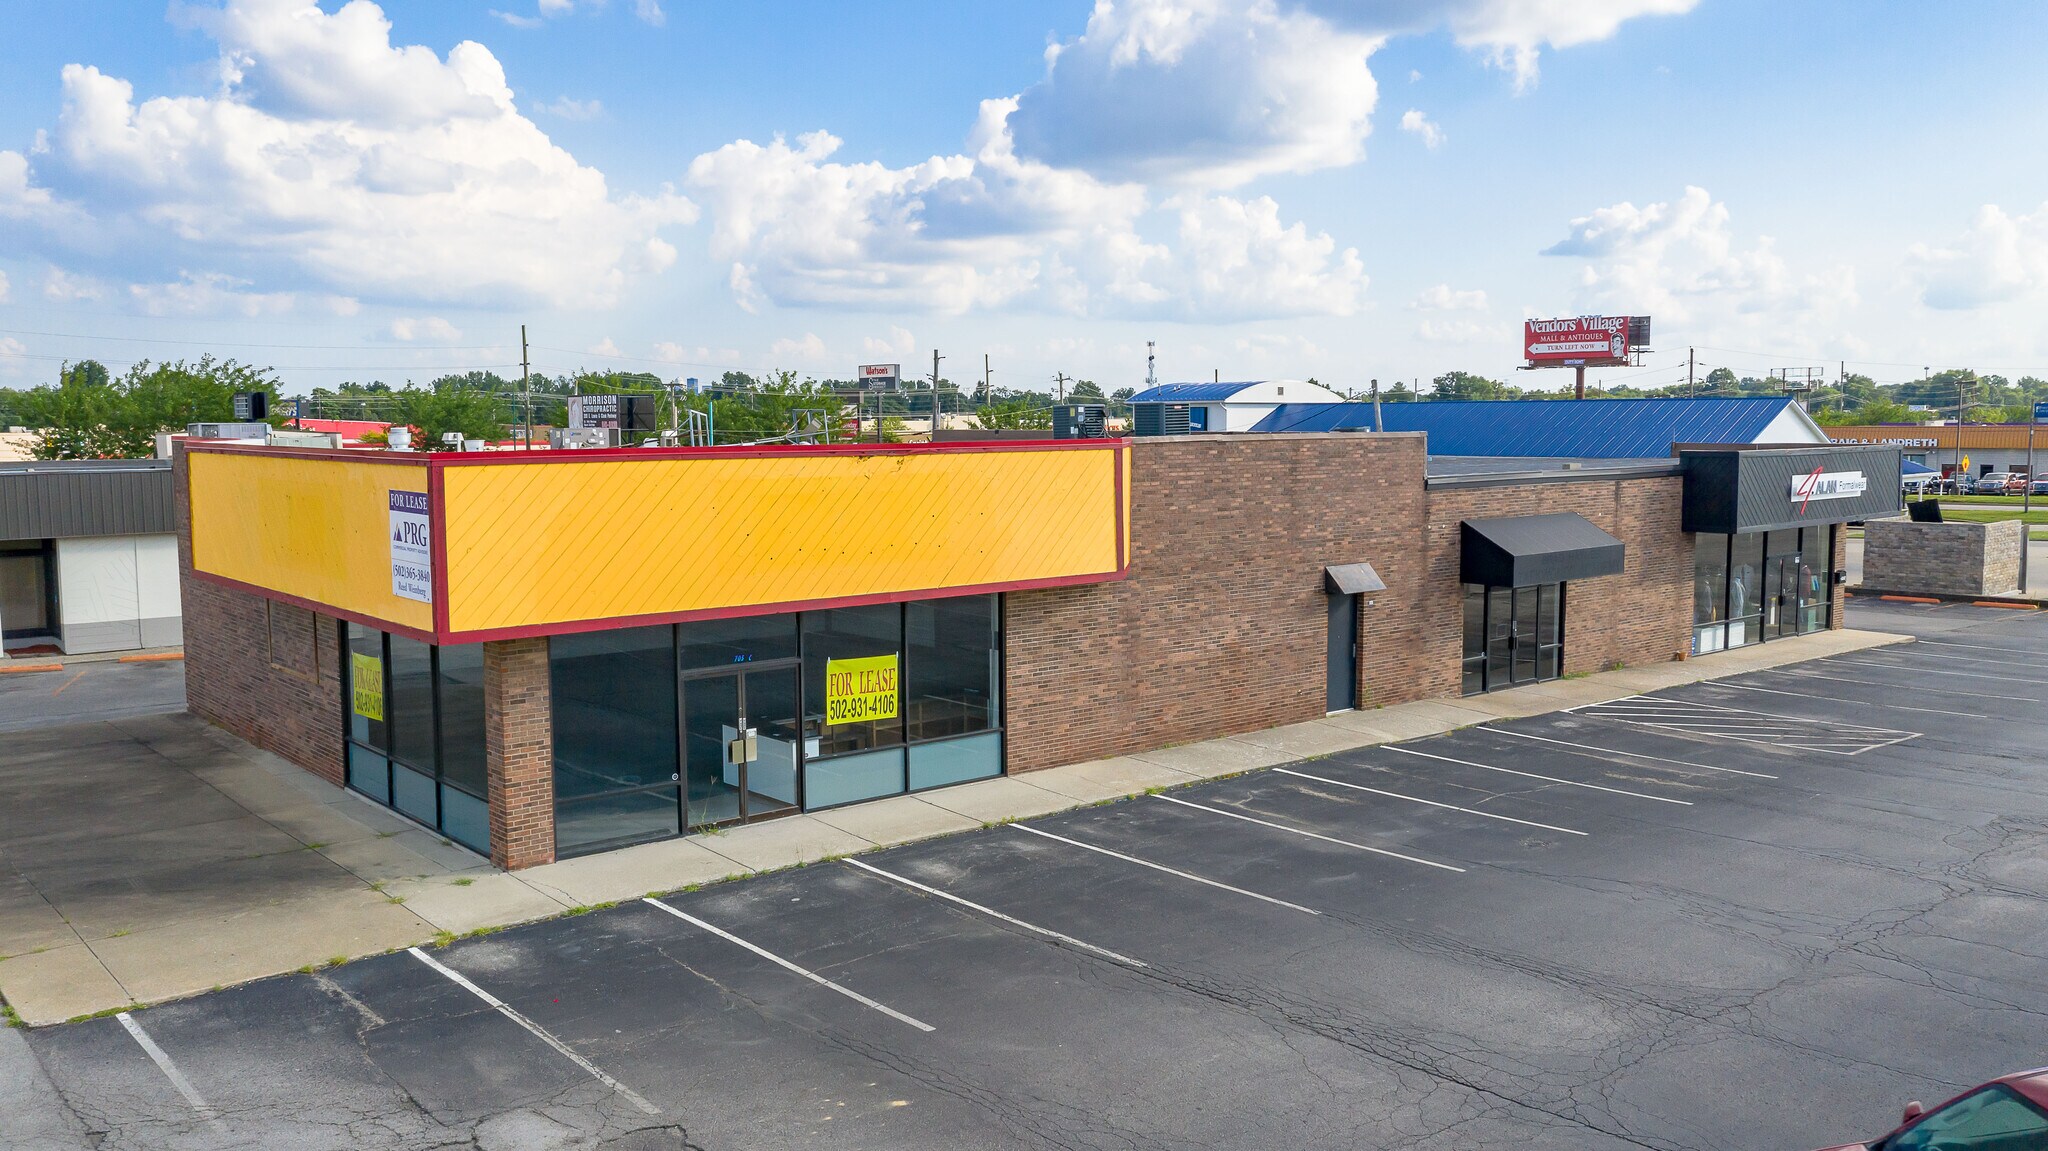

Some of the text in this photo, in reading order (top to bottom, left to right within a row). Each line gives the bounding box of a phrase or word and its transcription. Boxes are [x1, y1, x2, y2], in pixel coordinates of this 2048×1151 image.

[1528, 315, 1624, 333] Vendors' Village
[1567, 333, 1604, 341] ANTIQUES
[865, 366, 888, 375] Watson's
[582, 395, 617, 405] MORRISON
[1873, 438, 1938, 447] LANDRETH
[1815, 480, 1837, 495] ALAN
[390, 493, 428, 510] FOR LEASE
[403, 521, 427, 547] PRG
[393, 564, 430, 582] (502)365-3840
[829, 668, 896, 697] FOR LEASE
[829, 694, 895, 720] 502-931-4106
